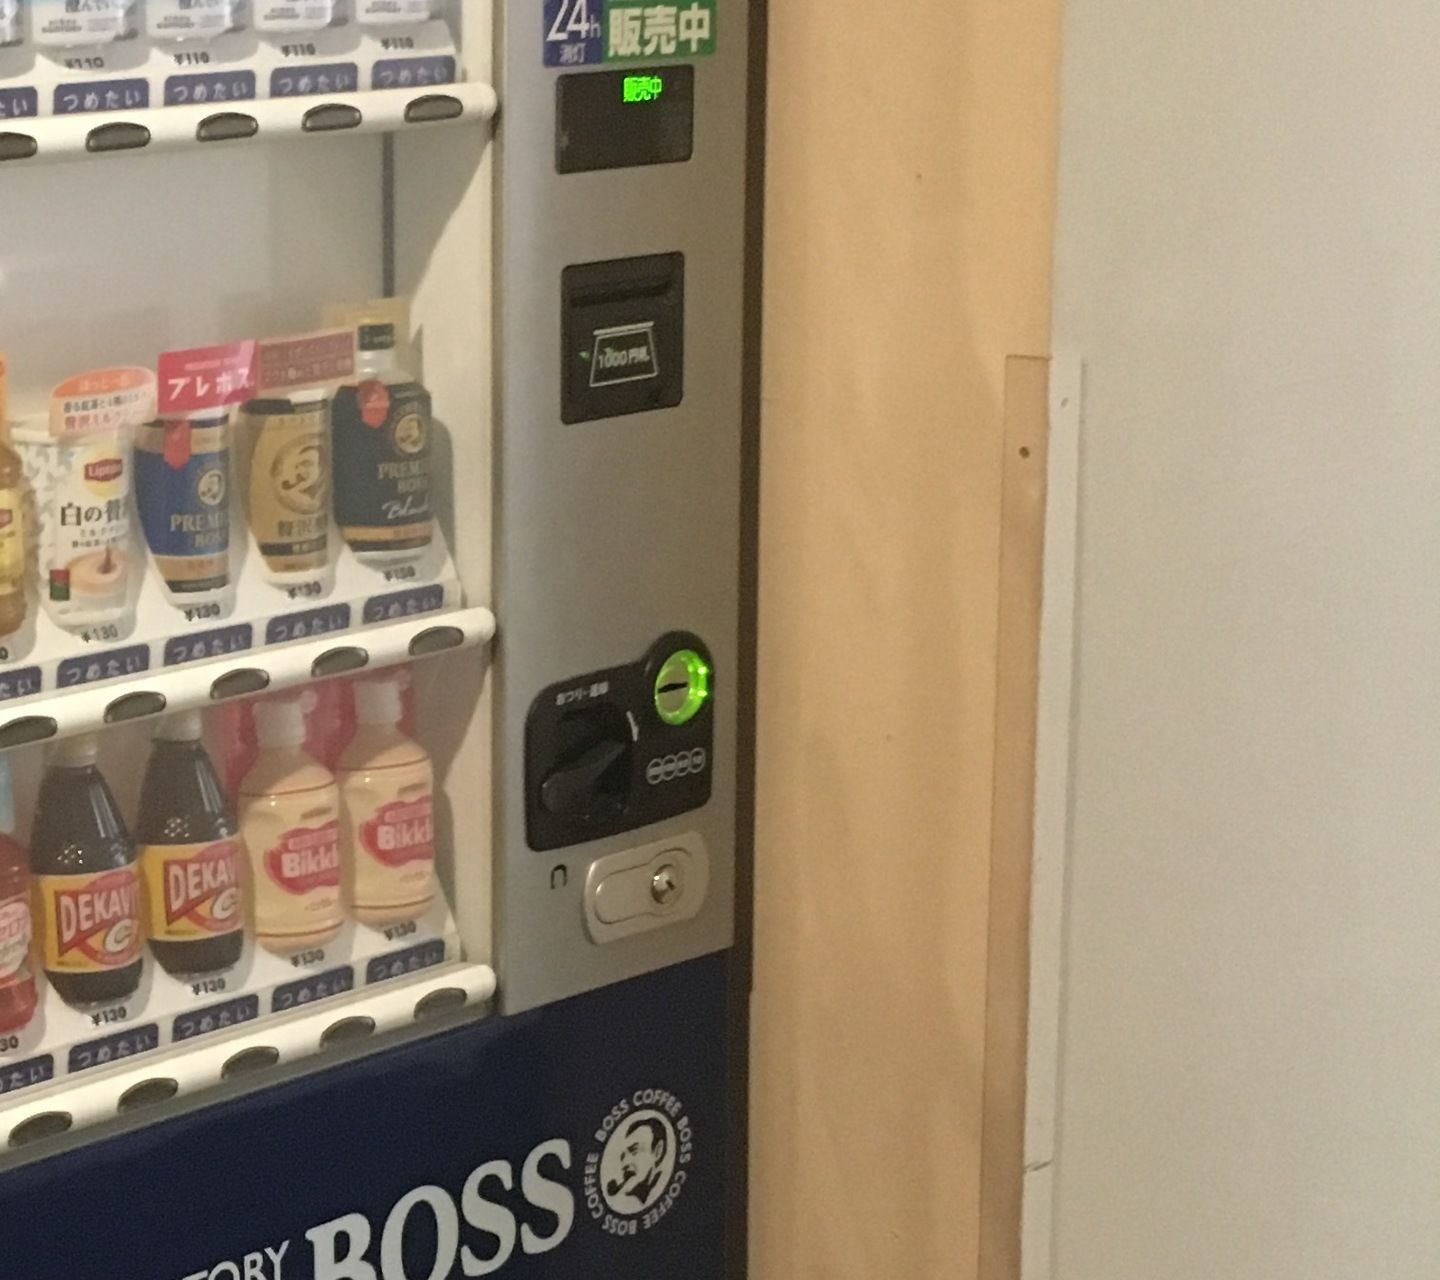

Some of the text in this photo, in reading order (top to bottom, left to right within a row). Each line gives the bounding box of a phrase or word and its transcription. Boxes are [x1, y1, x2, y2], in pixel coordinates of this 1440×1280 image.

[608, 2, 711, 58] 販売中
[64, 57, 105, 70] ¥110
[380, 66, 448, 85] つめたい
[173, 80, 248, 101] つめたい
[279, 73, 350, 93] つめたい
[623, 75, 663, 103] 販売中
[63, 90, 142, 113] つめたい
[372, 595, 437, 620] つめたい
[81, 624, 119, 644] ¥130
[274, 614, 344, 642] つめたい
[173, 634, 245, 663] つめたい
[67, 655, 143, 685] つめたい
[373, 950, 439, 980] つめたい
[279, 977, 348, 1007] つめたい
[92, 1007, 127, 1027] ¥130
[181, 1006, 252, 1036] つめたい
[77, 1032, 154, 1066] つめたい
[633, 1088, 682, 1117] COFFEE
[594, 1099, 630, 1142] BOSS
[677, 1116, 693, 1164] BOSS
[584, 1152, 604, 1219] COFFEE
